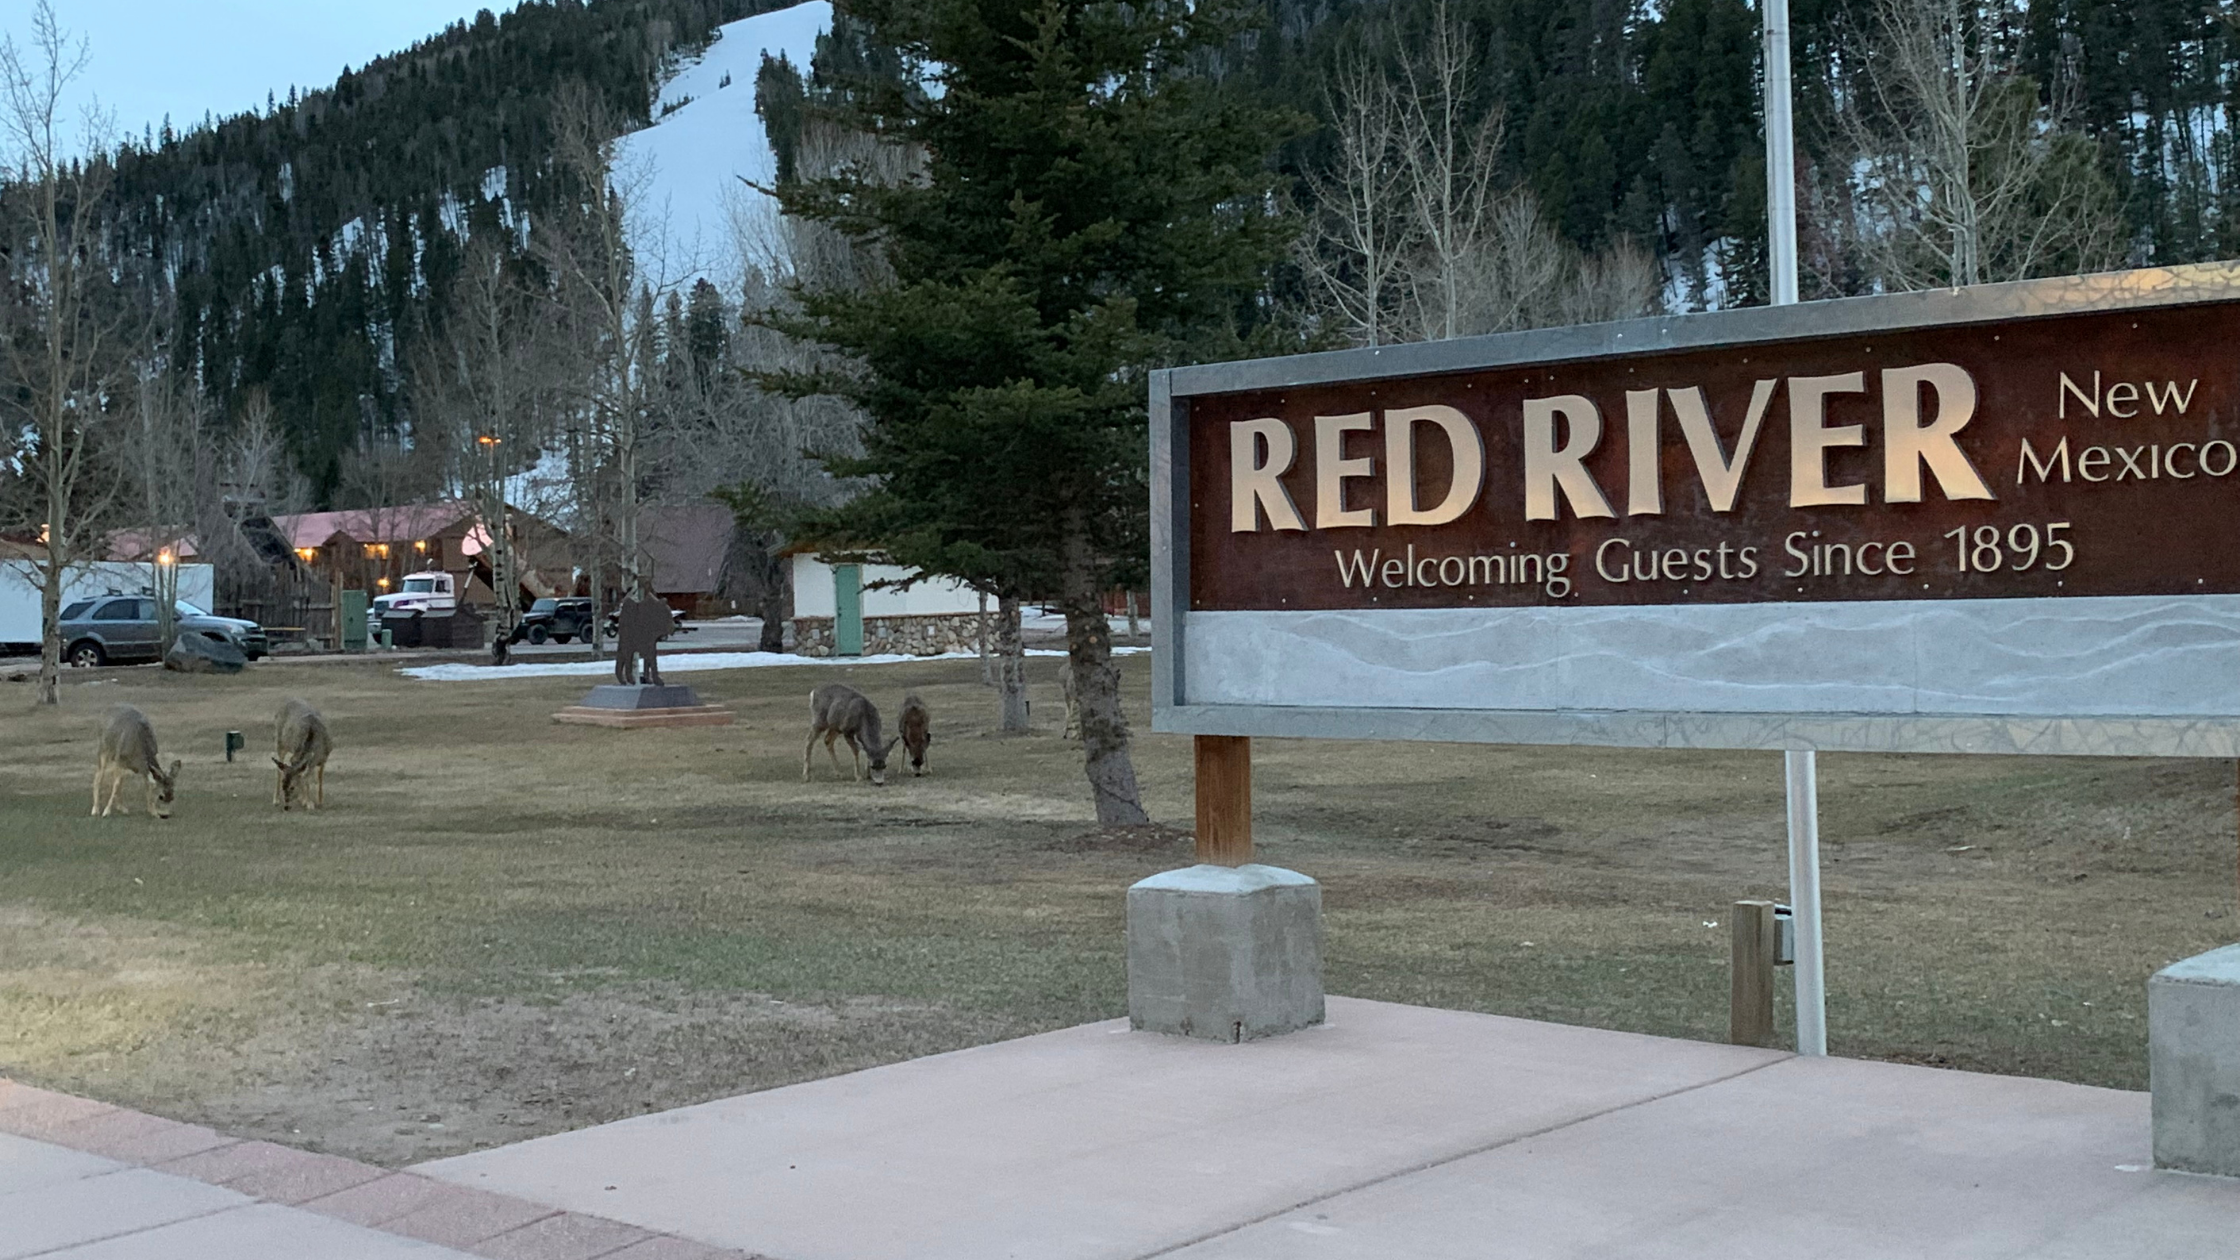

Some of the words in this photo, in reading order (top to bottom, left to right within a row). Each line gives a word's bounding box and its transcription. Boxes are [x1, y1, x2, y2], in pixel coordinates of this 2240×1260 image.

[2058, 370, 2198, 419] New
[1230, 404, 1486, 533] RED
[1523, 362, 1998, 521] RIVER
[2016, 436, 2237, 484] Mexico
[1334, 543, 1571, 598] Welcoming
[1595, 538, 1758, 583] Guests
[1784, 531, 1916, 578] Since
[1943, 521, 2075, 573] 1895
